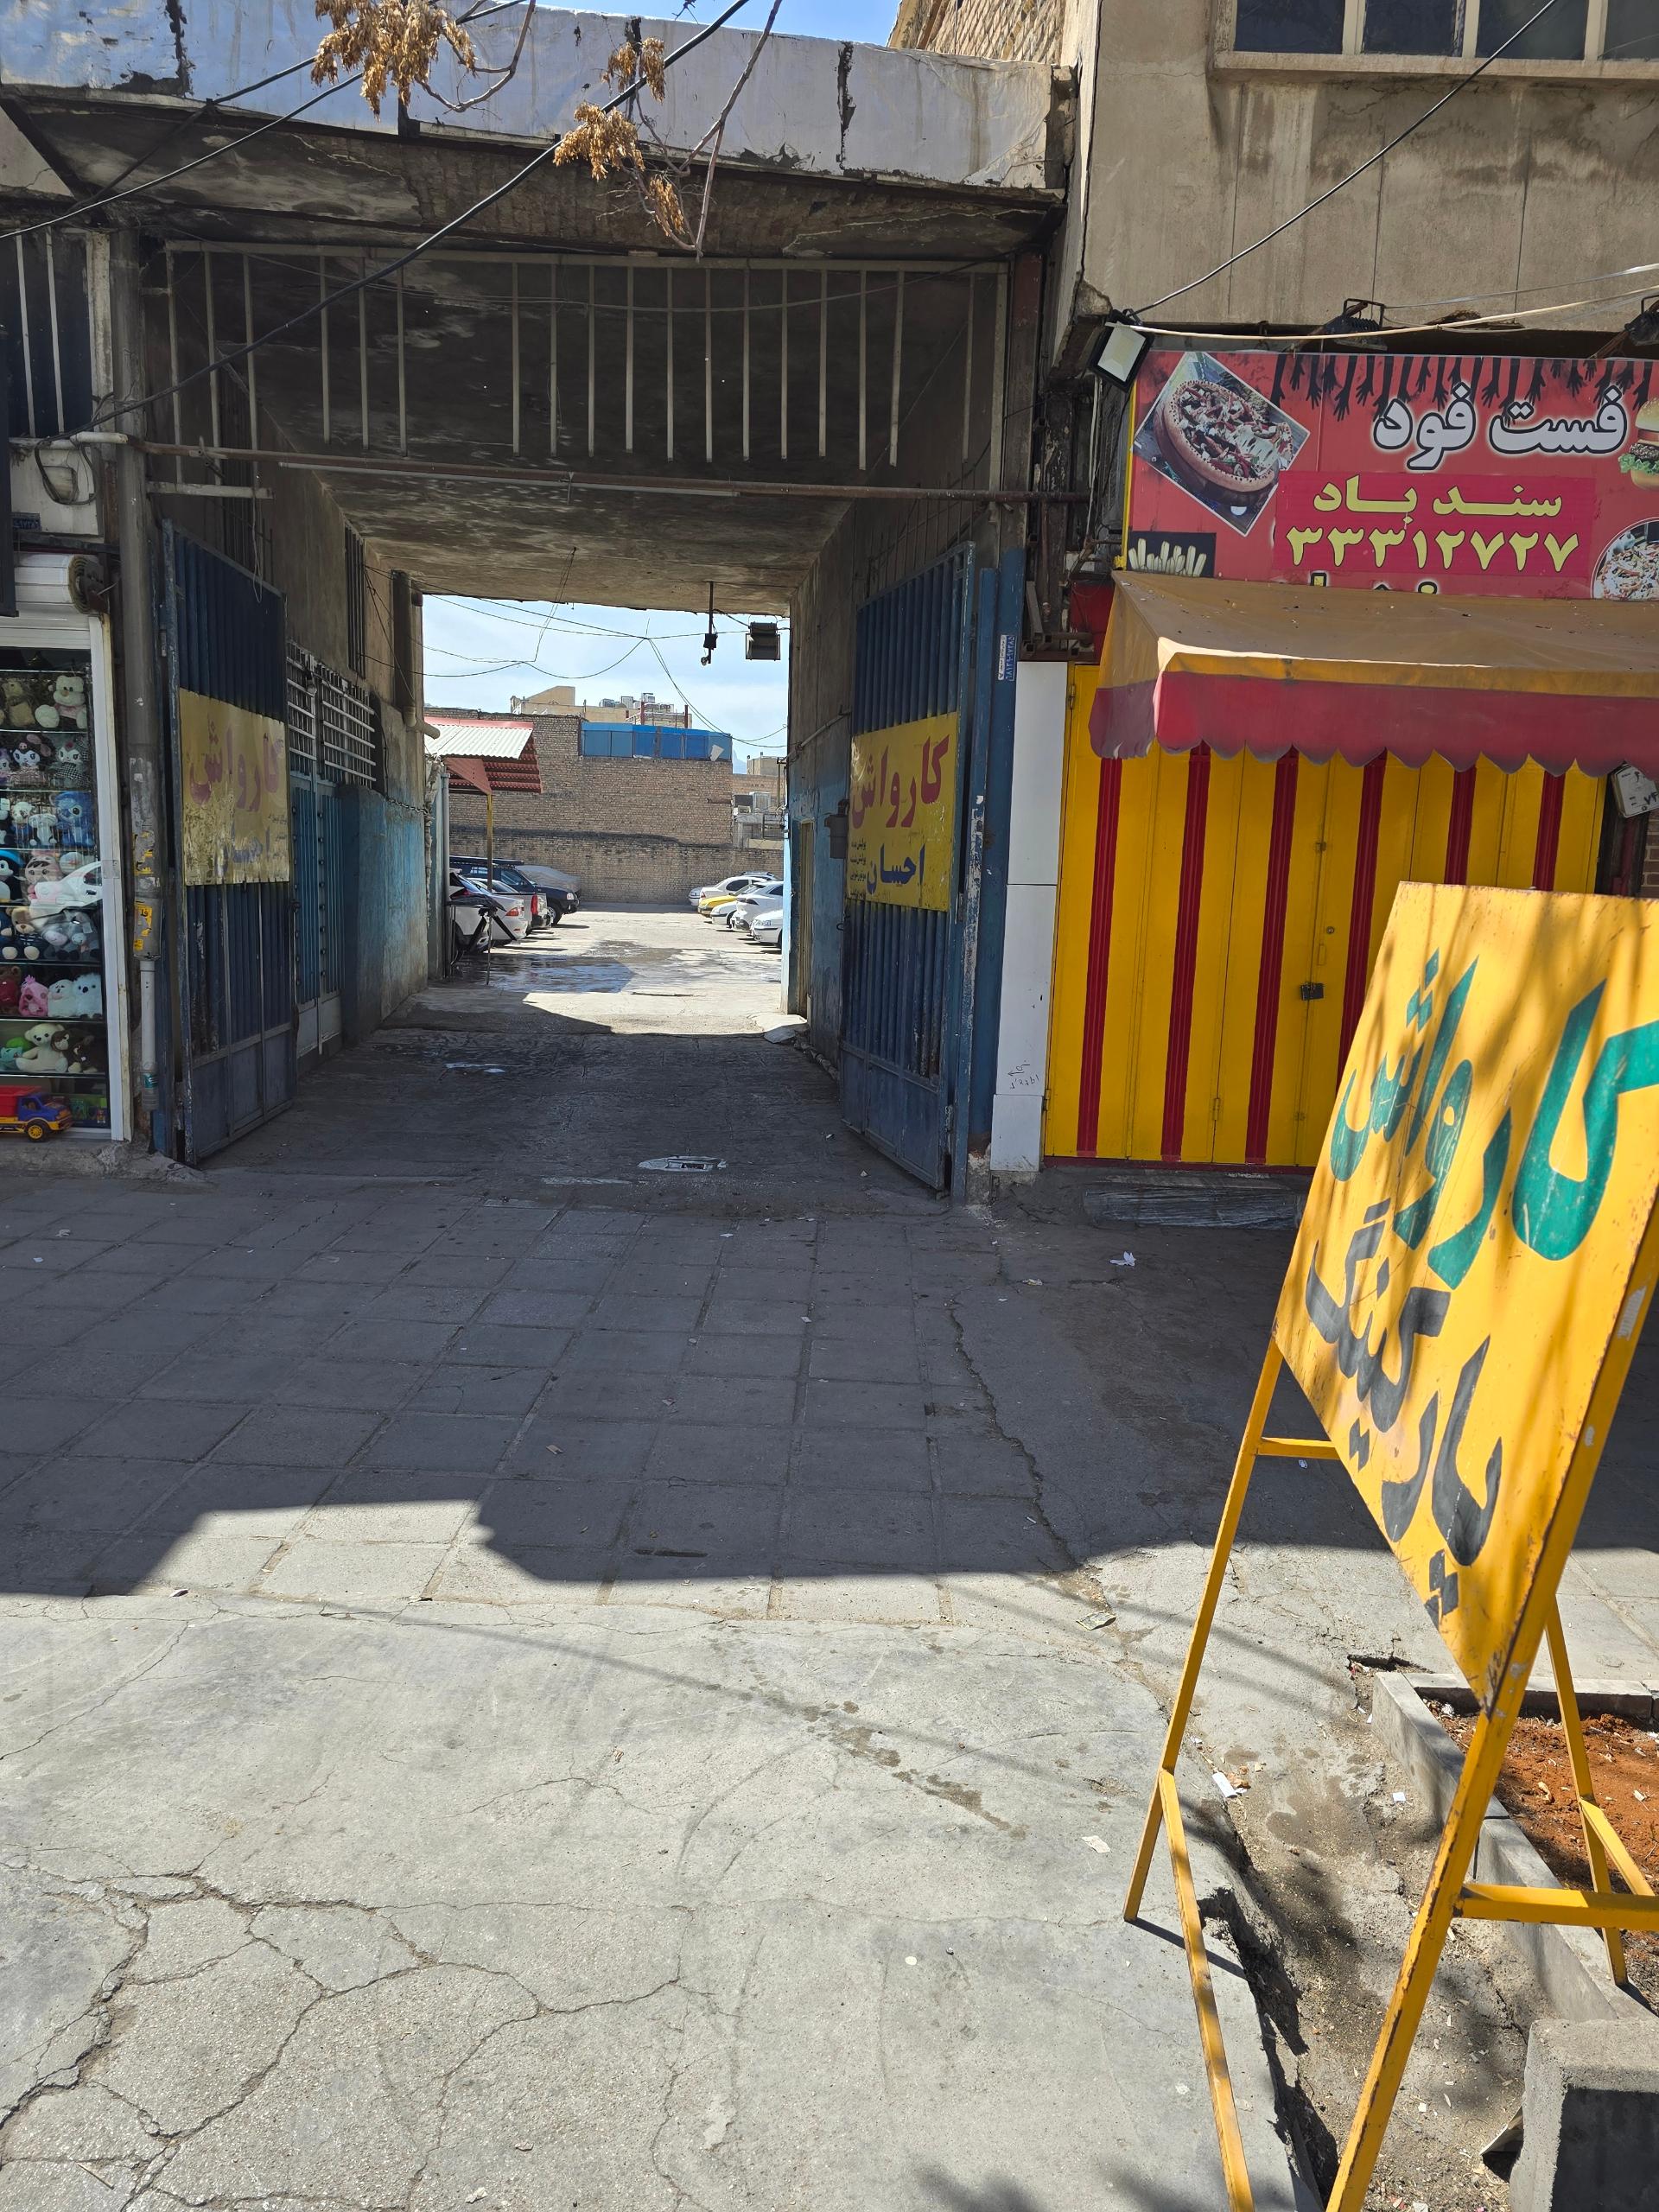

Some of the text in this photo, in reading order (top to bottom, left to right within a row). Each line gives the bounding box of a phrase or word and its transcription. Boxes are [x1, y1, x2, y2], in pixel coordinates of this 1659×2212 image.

[1372, 381, 1628, 471] فست فود
[1313, 474, 1564, 525] سند باد
[1285, 525, 1580, 574] ۳۳۳۱۲۷۲۷
[852, 734, 950, 829] کارواش
[867, 843, 925, 895] احسان
[1330, 946, 1659, 1289] کارواش
[1306, 1197, 1503, 1630] پارکینگ
